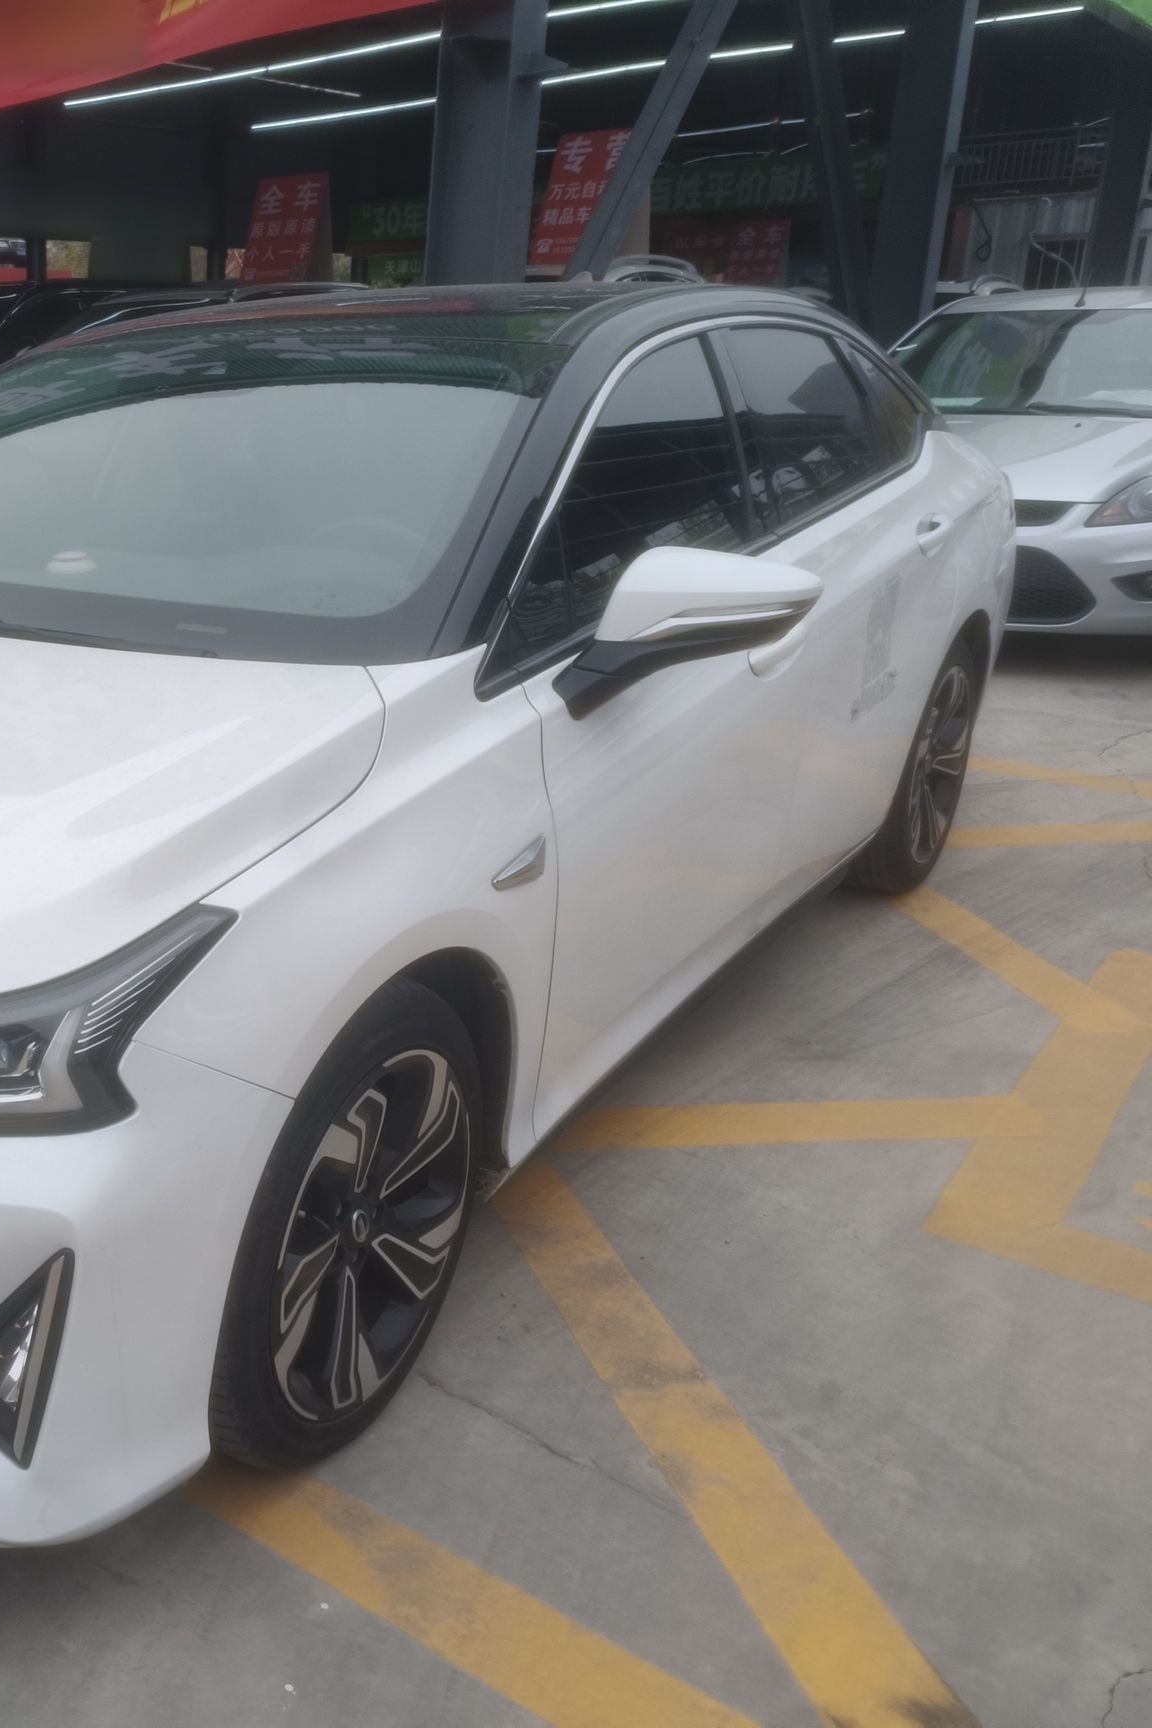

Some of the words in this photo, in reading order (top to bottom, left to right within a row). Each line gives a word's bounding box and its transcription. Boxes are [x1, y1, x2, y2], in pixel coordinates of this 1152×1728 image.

[259, 181, 320, 215] 全车
[246, 241, 313, 263] 个人一手
